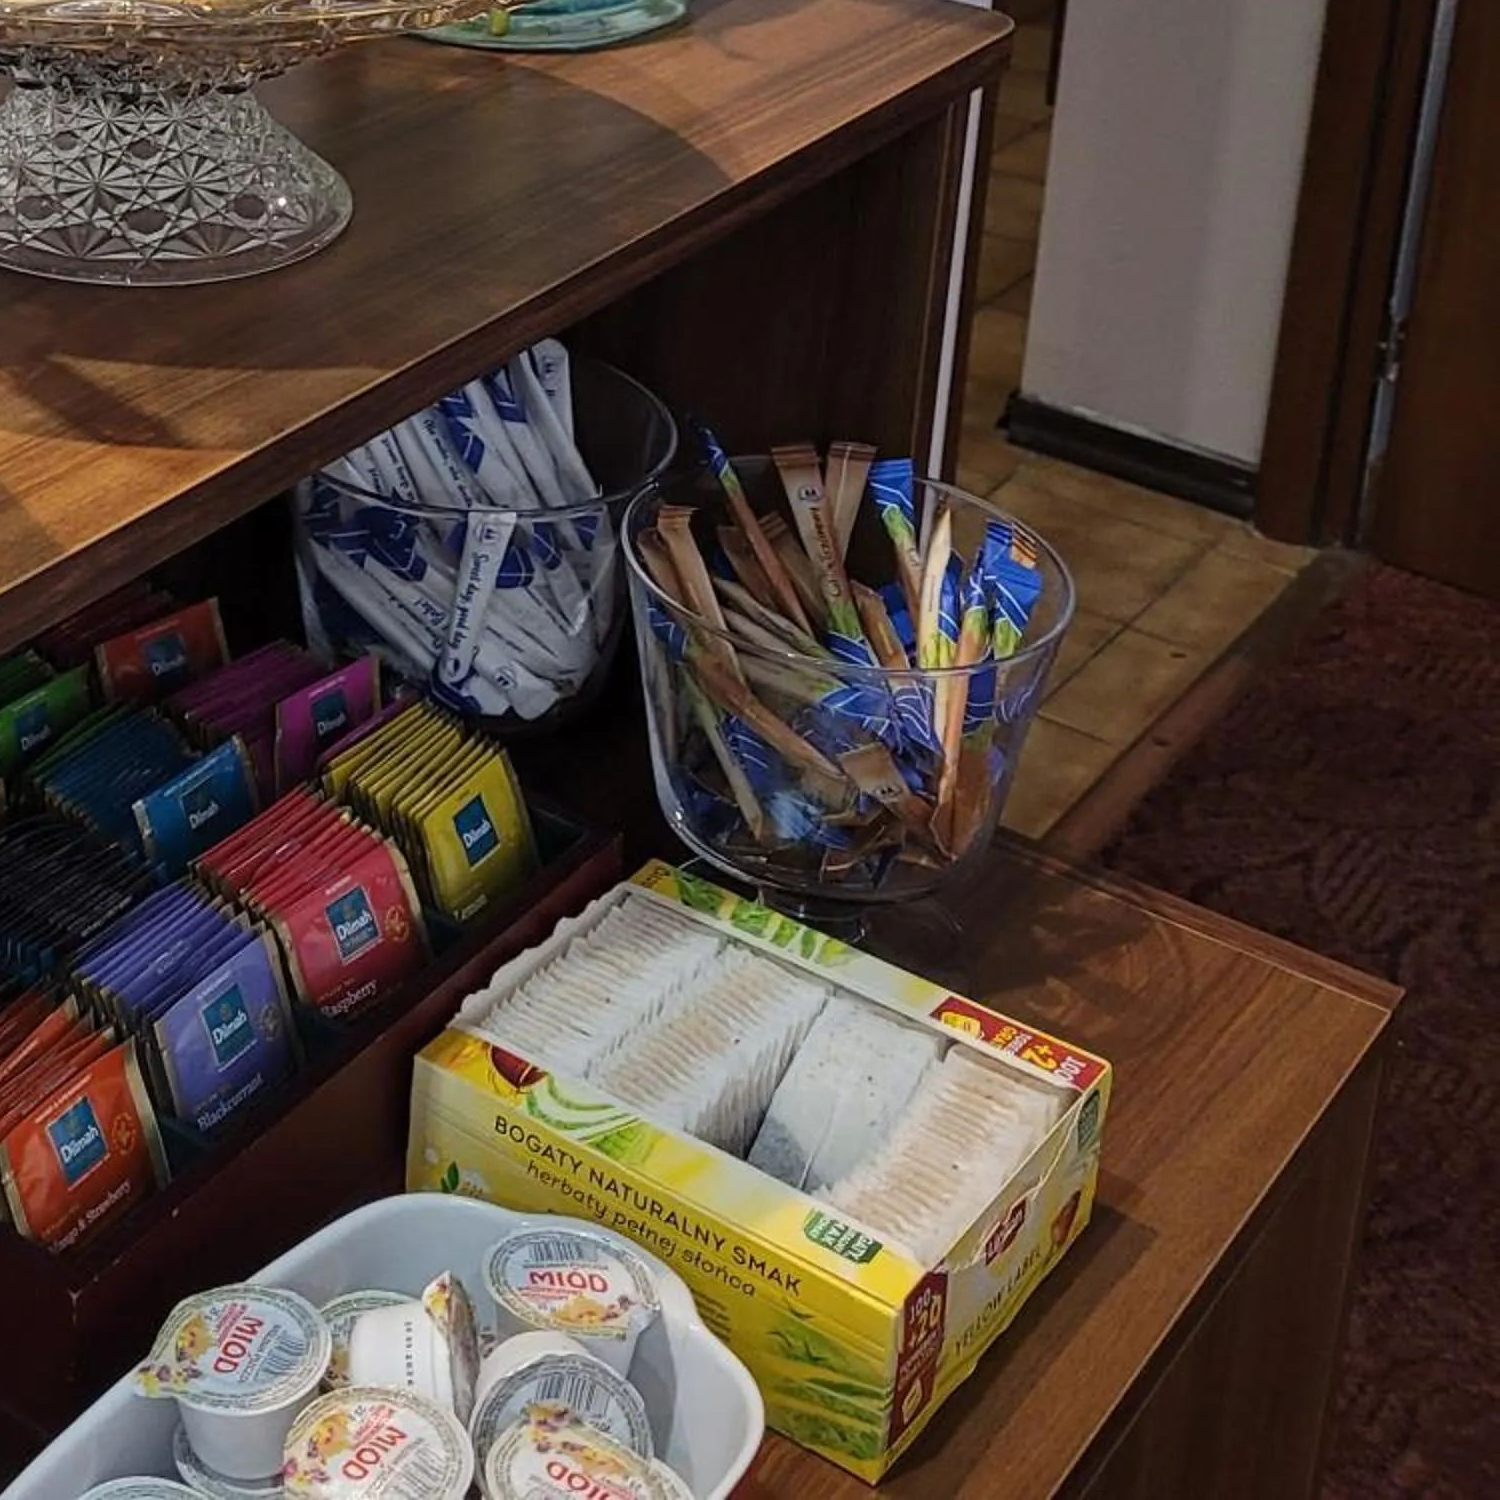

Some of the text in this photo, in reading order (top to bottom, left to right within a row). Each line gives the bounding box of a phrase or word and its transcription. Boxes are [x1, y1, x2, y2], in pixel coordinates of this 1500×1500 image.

[336, 908, 373, 941] Dilmah
[212, 1008, 248, 1045] Dilmah
[59, 1123, 100, 1163] Dilmah
[494, 1115, 804, 1296] BOGATY NATURALNY SMAK
[527, 1160, 756, 1296] herbaty pełnej słońca
[529, 1266, 609, 1293] MIÓD
